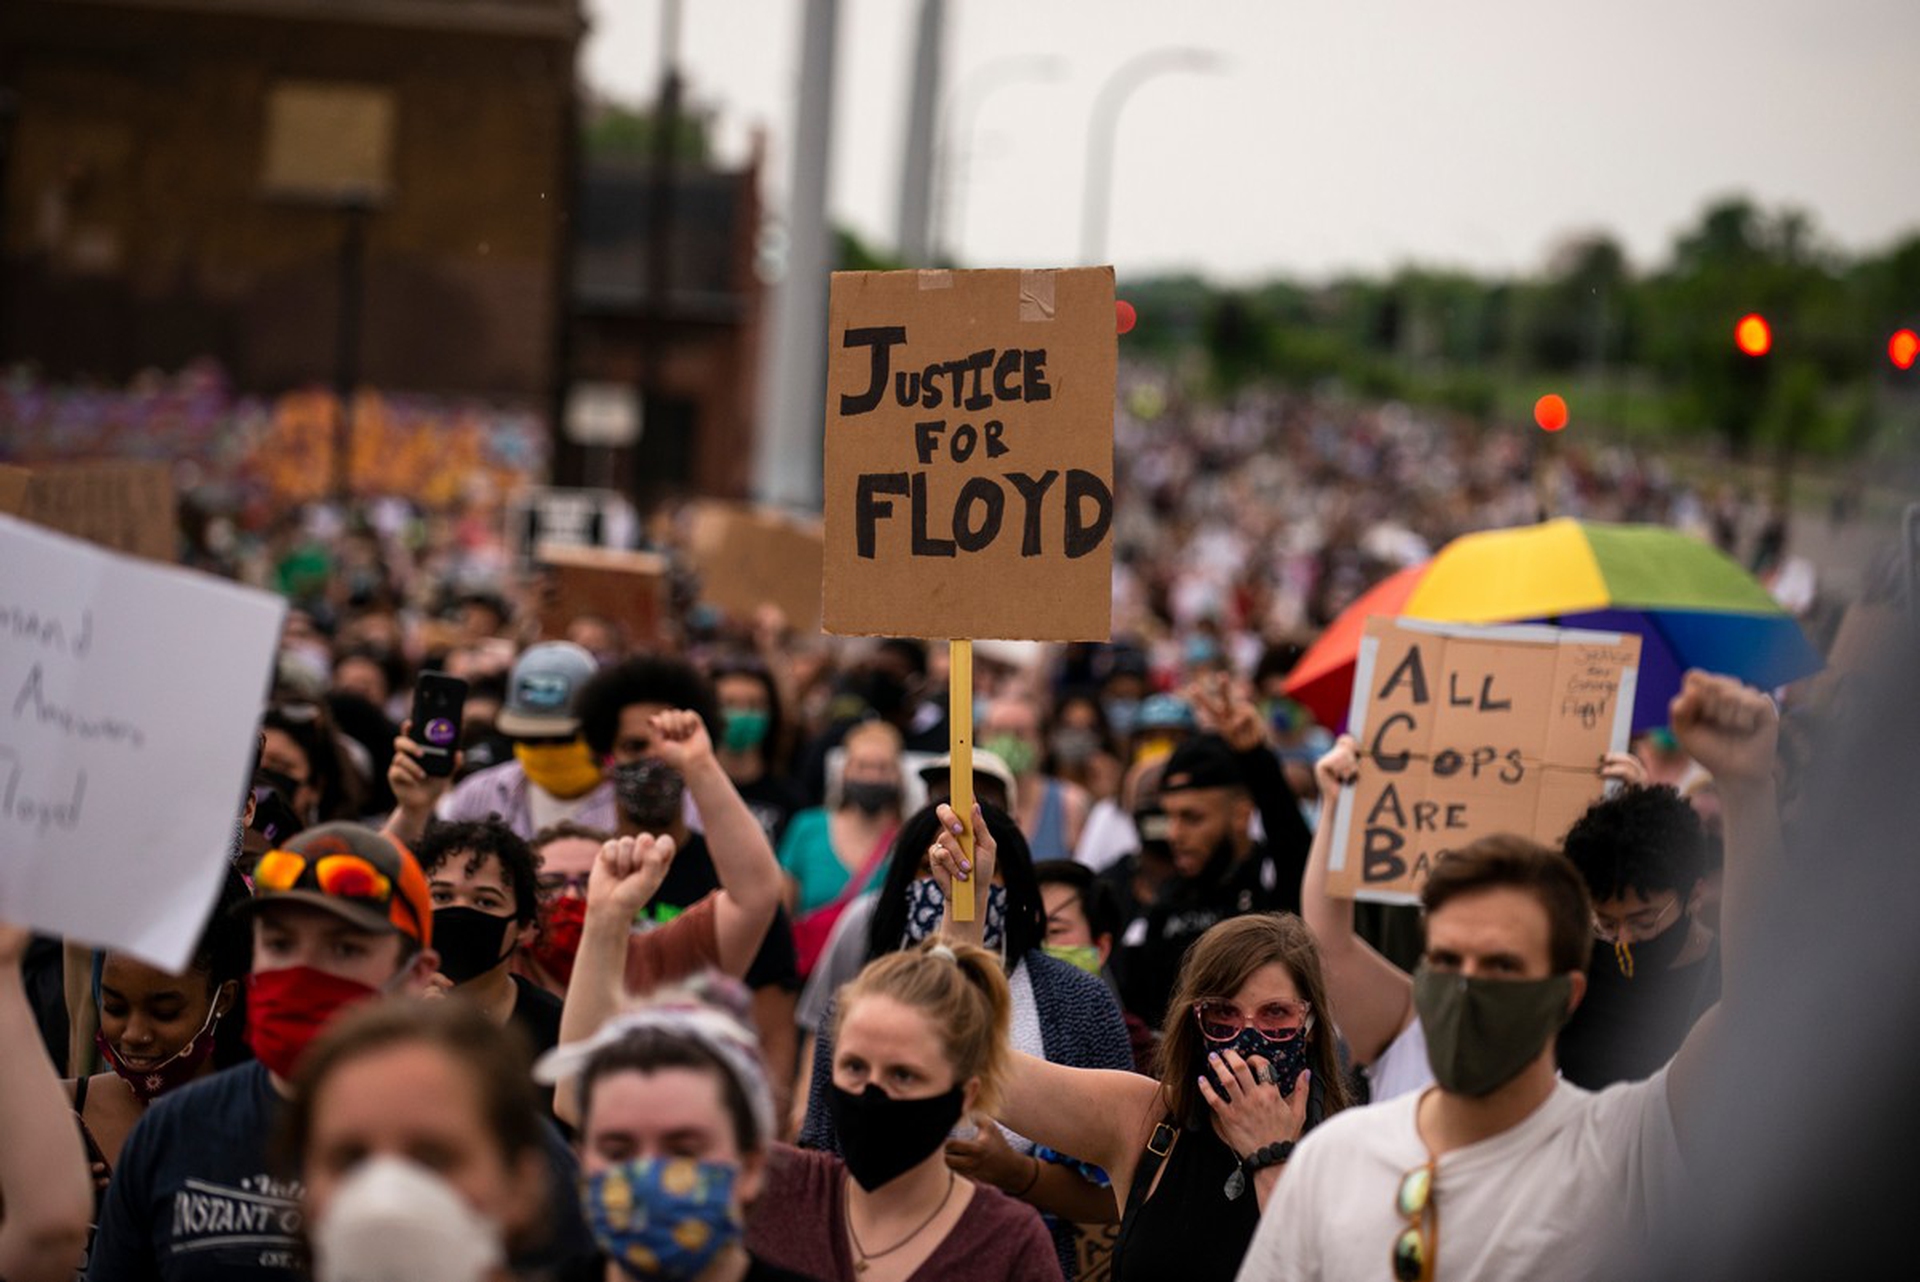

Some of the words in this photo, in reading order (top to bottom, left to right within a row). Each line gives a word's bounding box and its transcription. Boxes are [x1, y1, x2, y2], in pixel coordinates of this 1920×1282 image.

[840, 325, 1052, 416] JUSTICE
[914, 420, 1010, 464] FOR
[855, 468, 1114, 559] FLOYD
[1377, 644, 1512, 712] ALL
[1371, 711, 1525, 785] COPS
[1366, 783, 1469, 831] ARE
[172, 1191, 276, 1236] INSTANT
